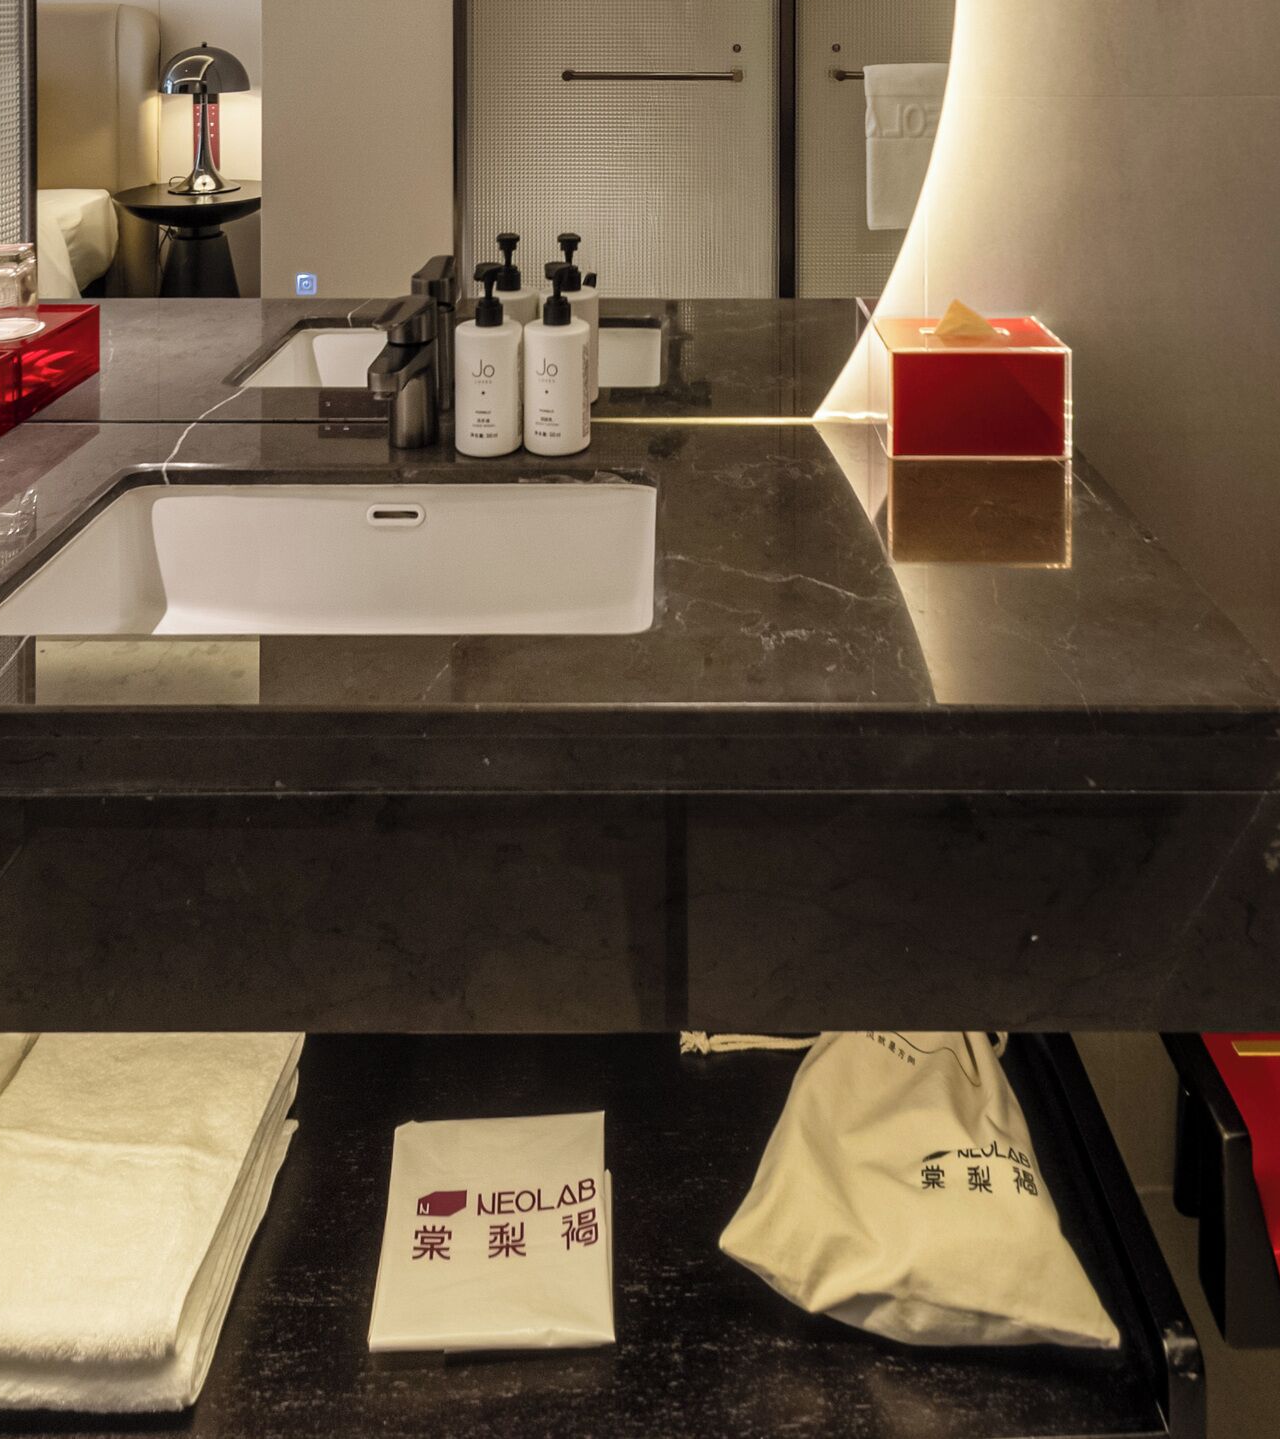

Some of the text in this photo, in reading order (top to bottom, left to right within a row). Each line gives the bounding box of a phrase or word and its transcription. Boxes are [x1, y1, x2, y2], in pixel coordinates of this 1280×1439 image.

[472, 359, 496, 378] Jo
[536, 357, 559, 377] Jo
[477, 1178, 597, 1217] NEOLAB
